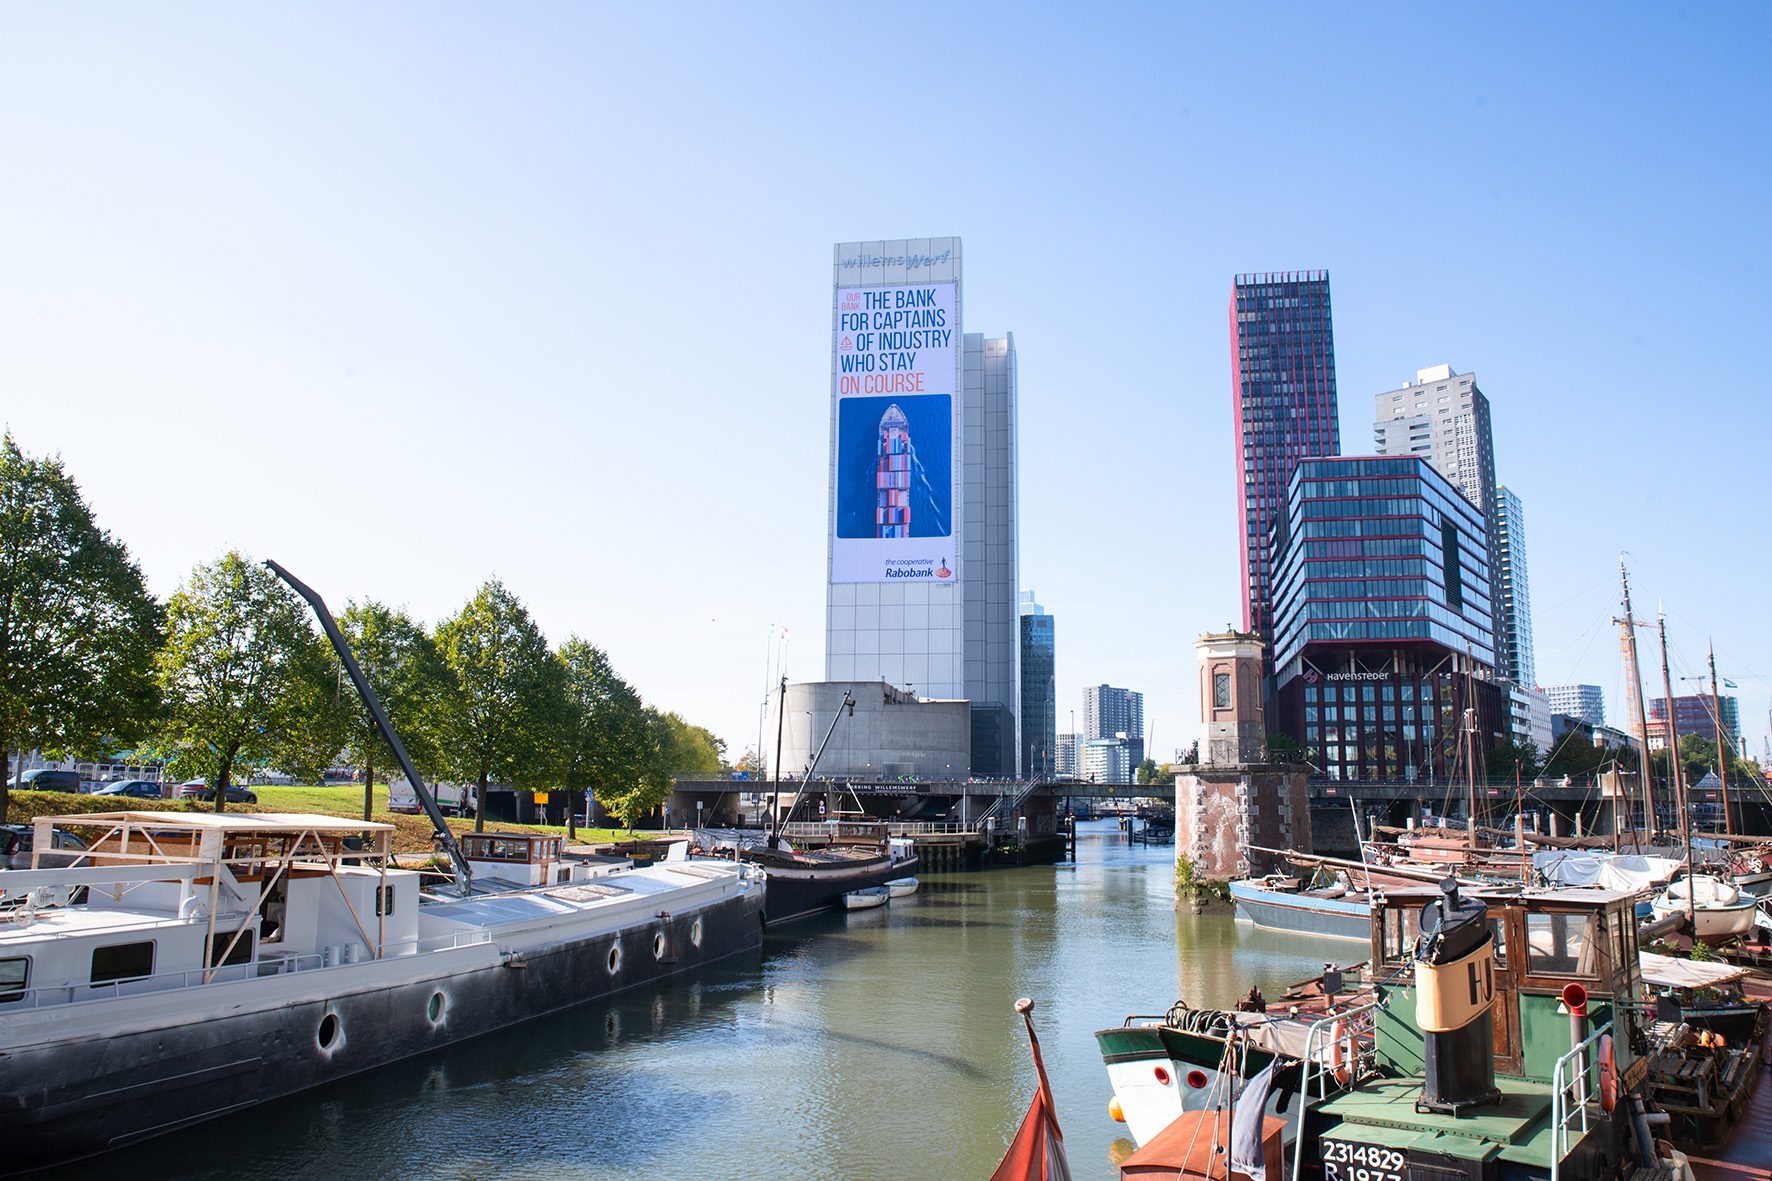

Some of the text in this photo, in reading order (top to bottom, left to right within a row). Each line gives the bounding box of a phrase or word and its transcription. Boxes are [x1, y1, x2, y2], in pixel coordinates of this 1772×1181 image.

[847, 293, 860, 301] OUR
[863, 289, 936, 310] THE BANK
[841, 309, 946, 331] FOR CAPTAINS
[856, 329, 951, 351] OF INDUSTRY
[841, 352, 916, 372] WHO STAY
[840, 372, 924, 394] ON COURSE
[885, 567, 933, 578] Rabobank
[896, 558, 933, 566] cooperative
[1323, 1140, 1404, 1172] 2314829
